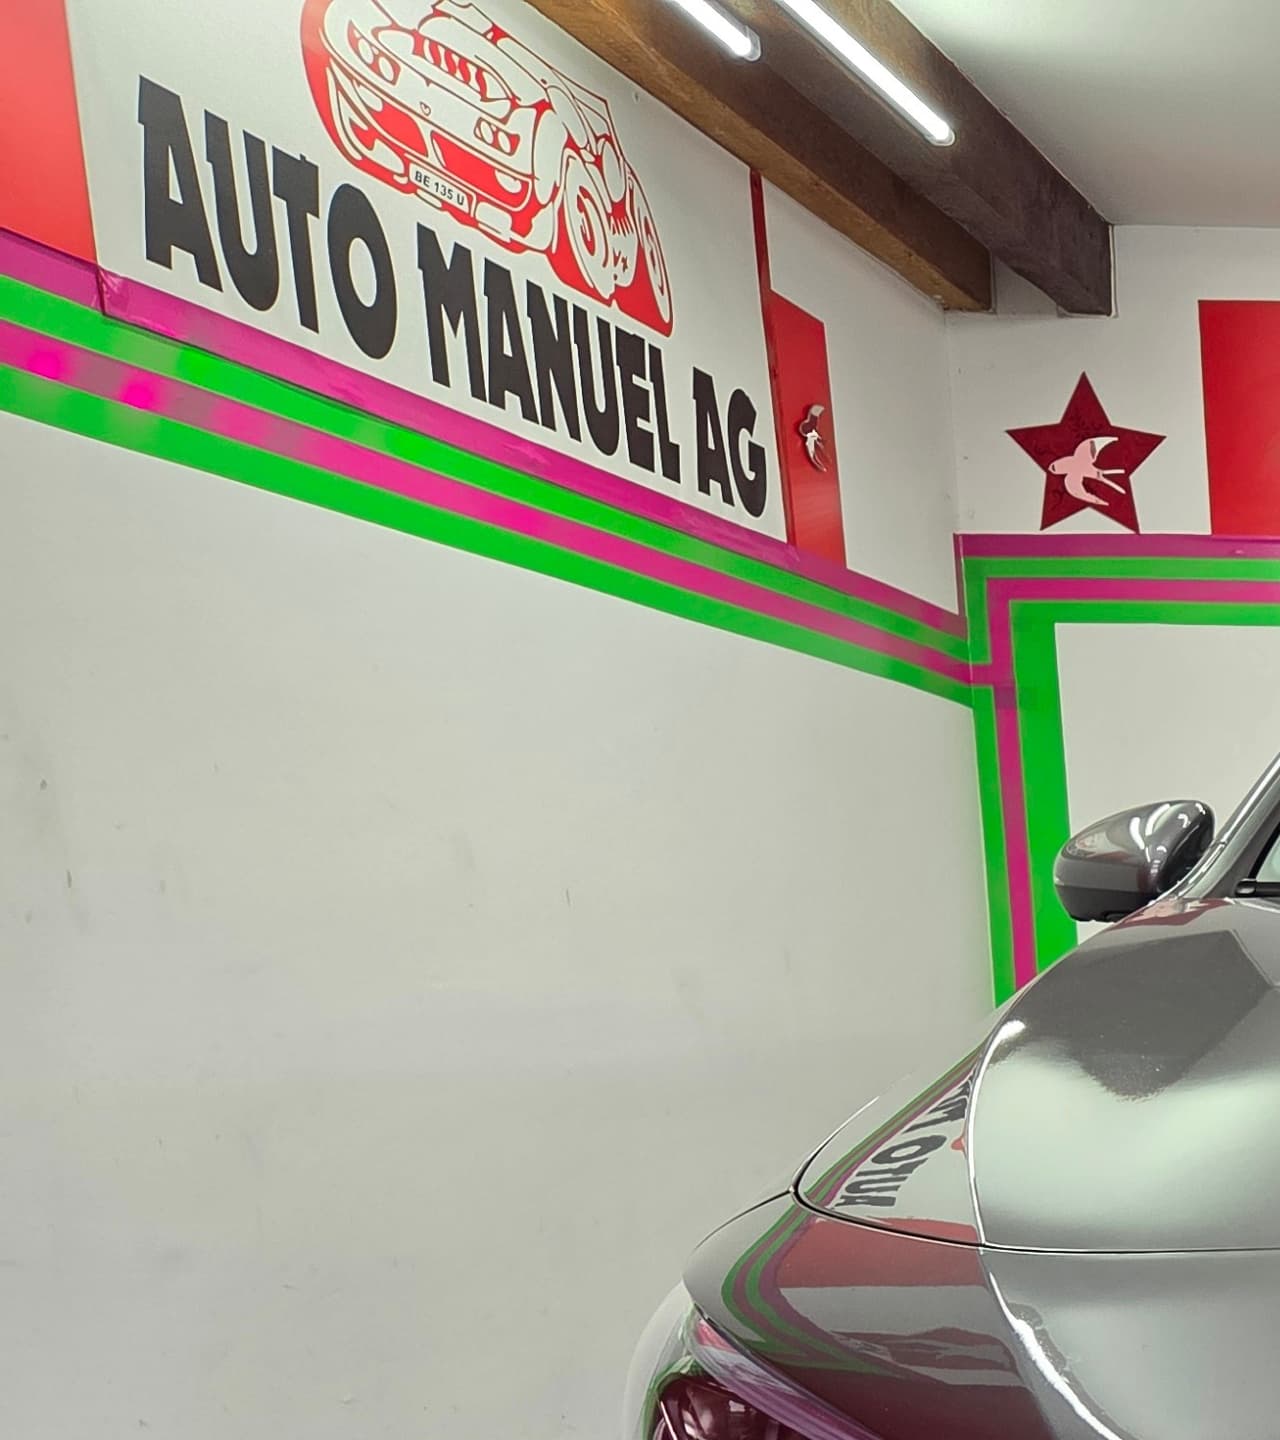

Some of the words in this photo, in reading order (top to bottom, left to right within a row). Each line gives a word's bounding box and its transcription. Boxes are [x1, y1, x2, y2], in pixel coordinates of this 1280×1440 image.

[138, 75, 397, 360] AUTO
[417, 222, 681, 484] MANUEL
[692, 366, 767, 518] AG
[414, 170, 430, 188] BE
[434, 181, 454, 200] 135
[456, 193, 465, 206] U
